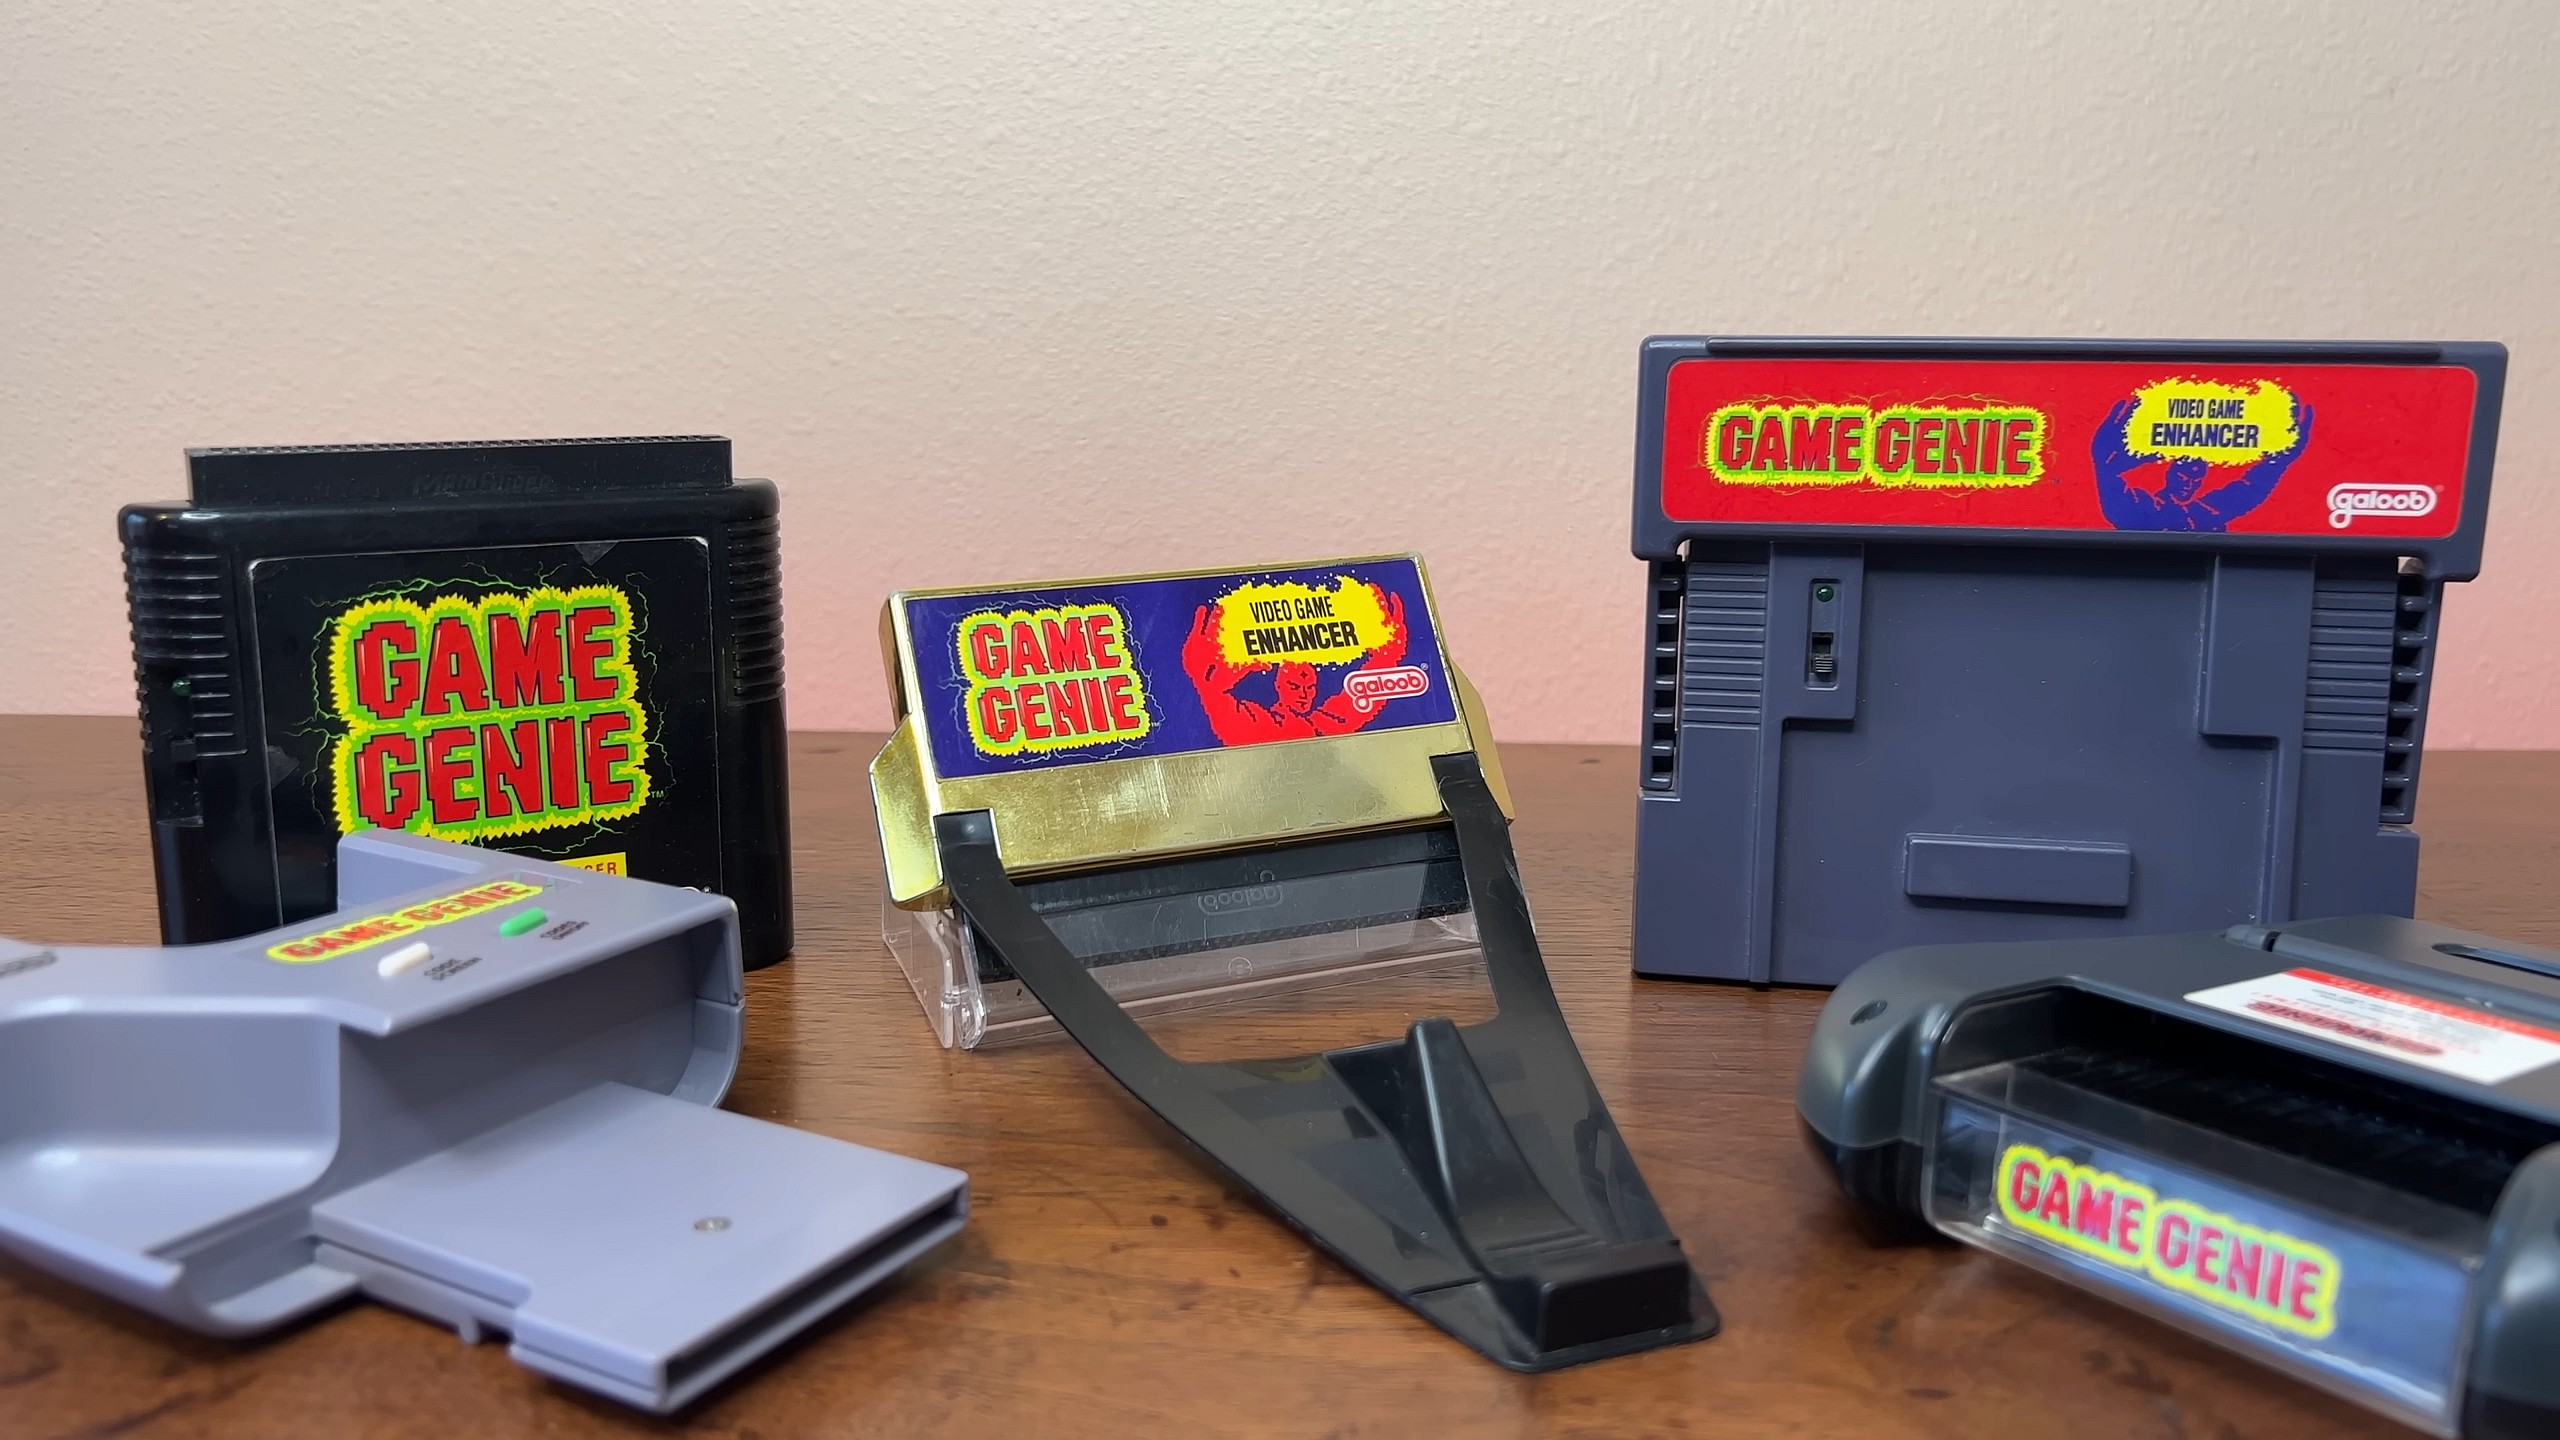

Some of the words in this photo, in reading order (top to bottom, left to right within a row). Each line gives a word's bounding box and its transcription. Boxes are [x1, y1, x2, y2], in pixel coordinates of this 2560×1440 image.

[2150, 422, 2260, 449] ENHANCER
[2168, 398, 2205, 419] VIDEO
[2208, 398, 2245, 420] GAME
[1718, 415, 1865, 473] GAME
[1872, 417, 2036, 475] GENIE
[2327, 483, 2438, 529] galoob
[1242, 620, 1360, 656] ENHANCER
[1249, 598, 1293, 624] VIDEO
[1294, 595, 1336, 621] GAME
[353, 605, 620, 720] GAME
[969, 613, 1122, 680] GAME
[977, 673, 1142, 743] GENIE
[1346, 667, 1428, 711] galoob
[353, 710, 635, 830] GENIE
[279, 917, 415, 958] GAME
[401, 882, 533, 922] GENIE
[2010, 1158, 2146, 1255] GAME
[2156, 1212, 2322, 1321] GENIE
